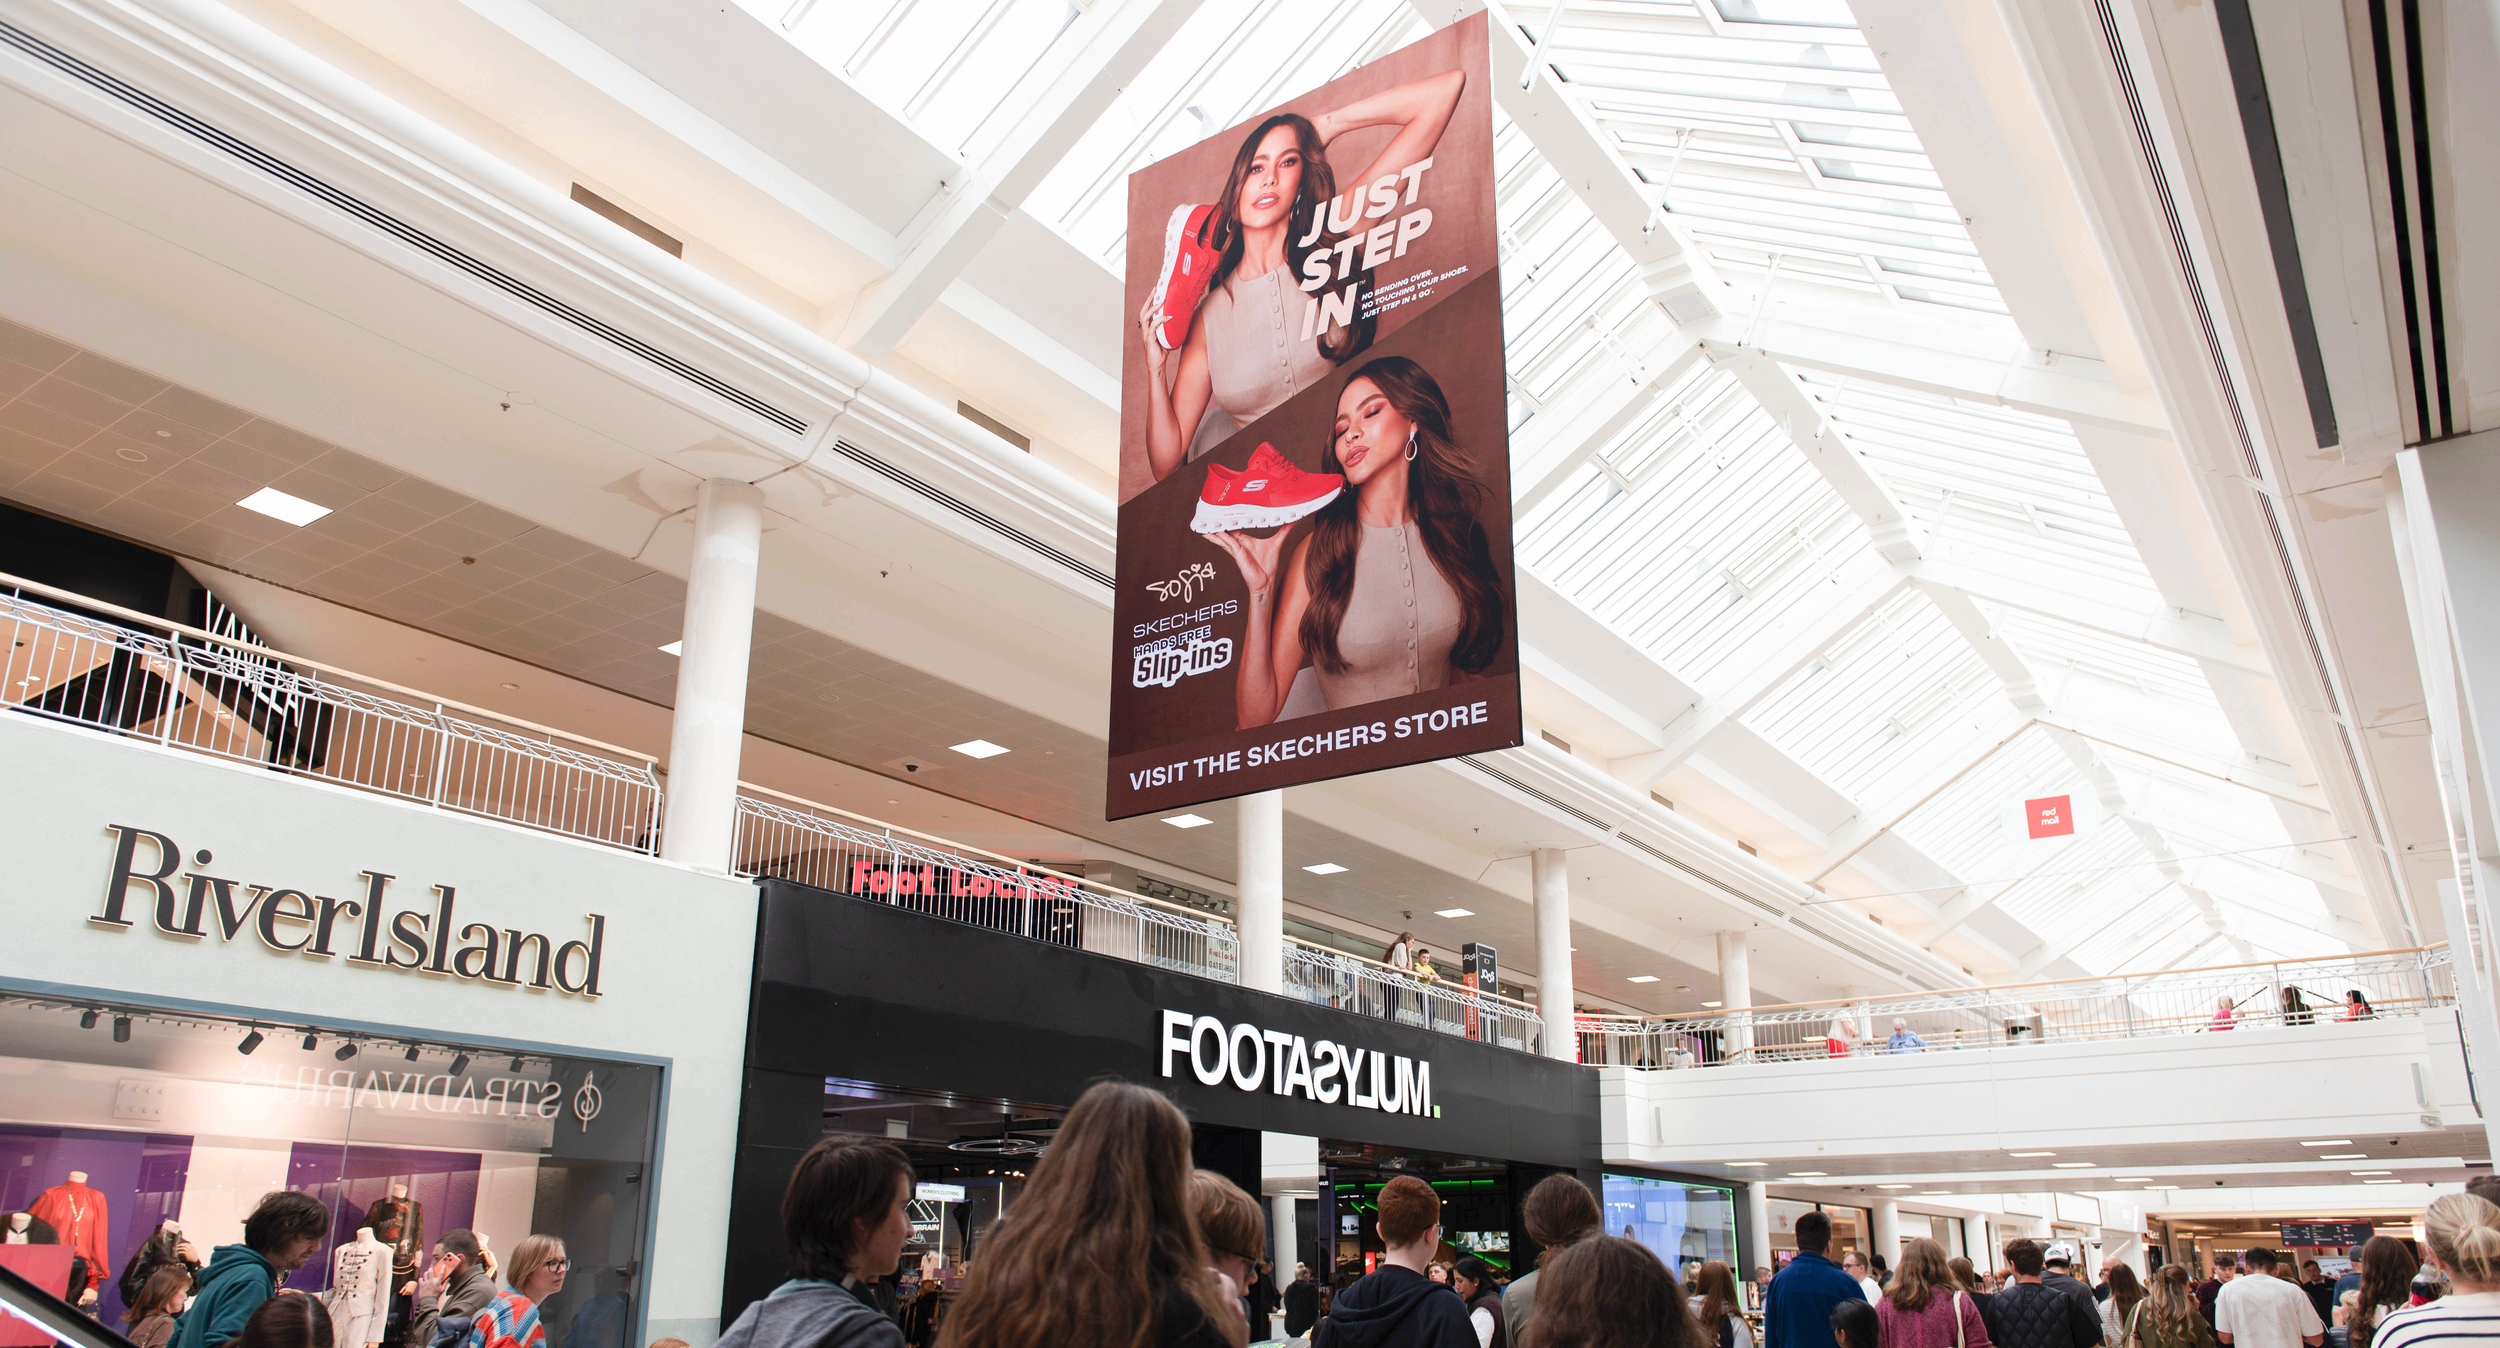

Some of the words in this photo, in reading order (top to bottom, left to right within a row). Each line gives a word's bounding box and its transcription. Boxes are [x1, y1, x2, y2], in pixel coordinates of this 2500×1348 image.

[1298, 156, 1434, 247] JUST
[1300, 208, 1433, 292] STEP
[1361, 291, 1373, 301] NO
[1374, 278, 1409, 297] BENDING
[1410, 269, 1433, 283] OVER.
[1361, 301, 1373, 311] NO
[1375, 285, 1415, 305] TOUCHING
[1417, 276, 1439, 290] YOUR
[1440, 265, 1469, 281] SHOES.
[1361, 307, 1381, 320] JUST
[1381, 300, 1401, 313] STEP
[1401, 296, 1411, 305] IN
[1411, 293, 1417, 301] &
[1133, 599, 1238, 639] SKECHERS
[1134, 636, 1176, 658] HANDS
[1179, 625, 1211, 645] FREE
[1136, 641, 1230, 684] Slip-ins
[1129, 761, 1188, 791] VISIT
[1193, 751, 1241, 778] THE
[1246, 721, 1387, 768] SKECHERS
[1394, 700, 1489, 739] STORE
[2041, 815, 2060, 826] mall
[2042, 806, 2057, 817] red
[852, 861, 936, 896] Foot
[951, 865, 1077, 900] Locker
[1480, 968, 1495, 983] JOOS
